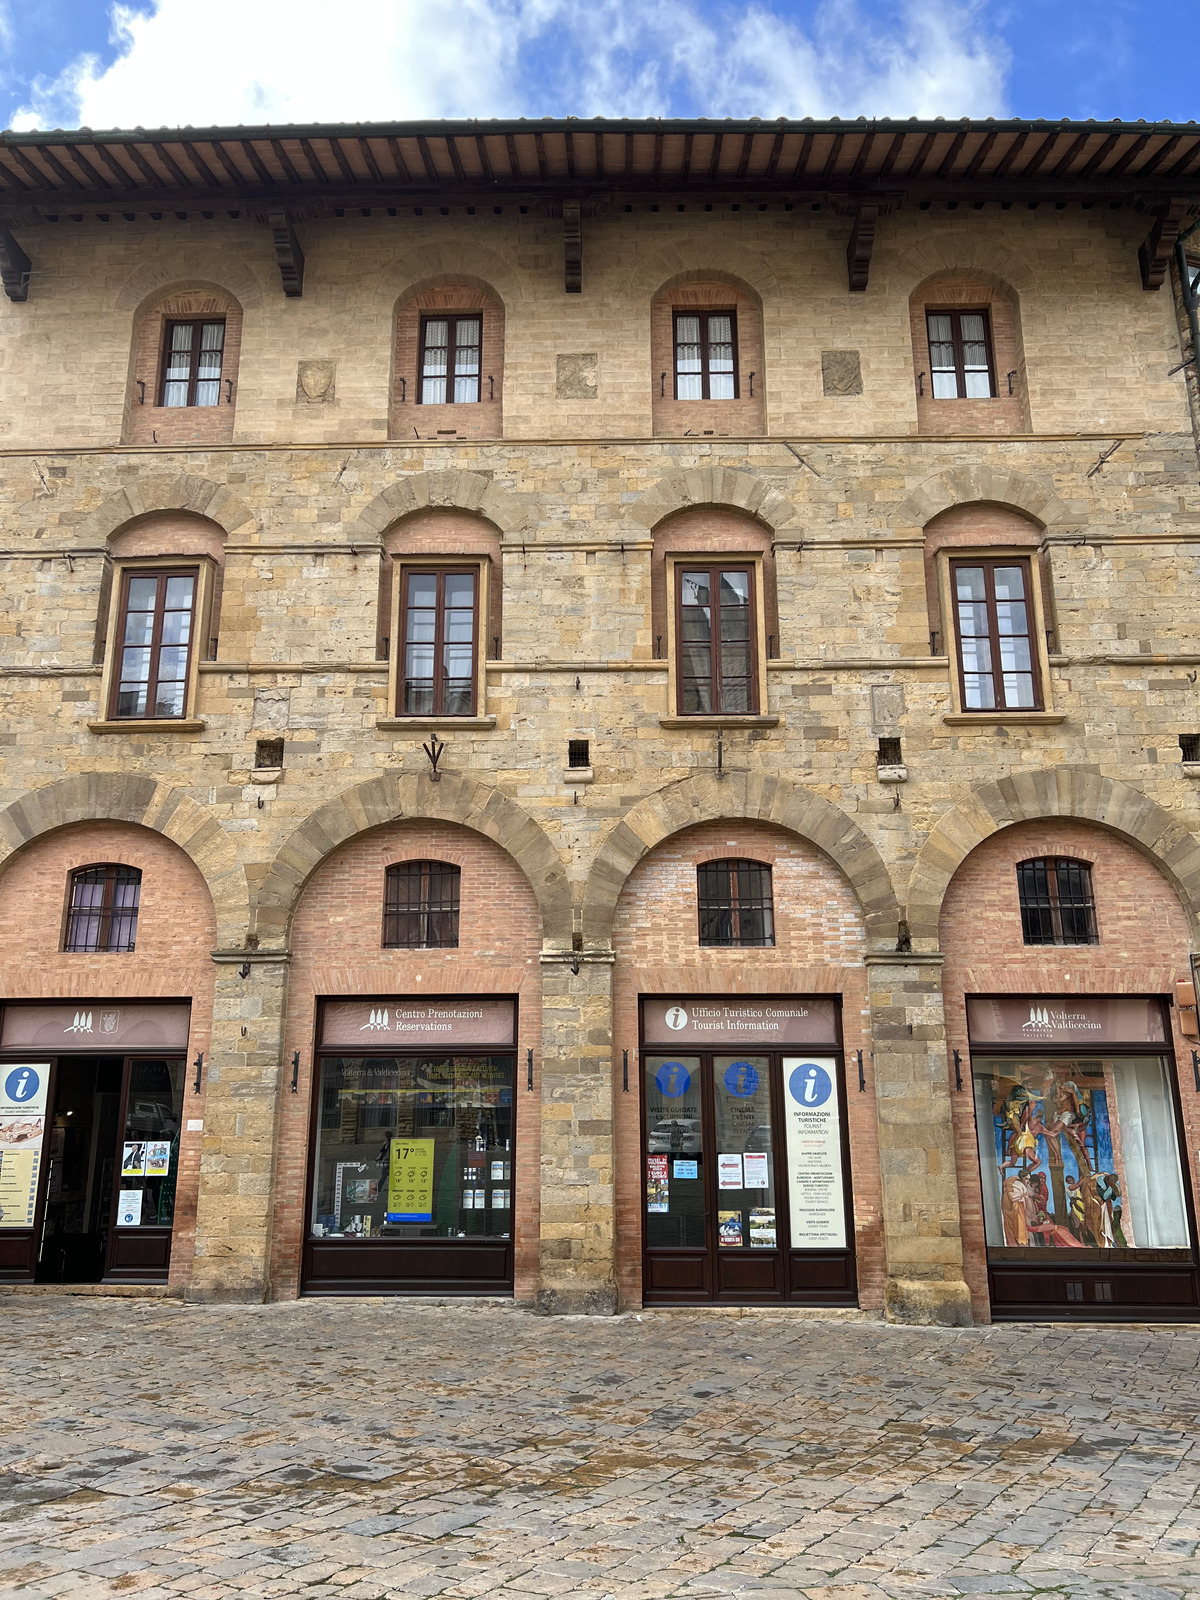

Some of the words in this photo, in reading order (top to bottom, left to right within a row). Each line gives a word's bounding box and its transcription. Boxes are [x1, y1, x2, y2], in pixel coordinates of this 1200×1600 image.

[395, 1009, 426, 1019] Centro
[428, 1008, 483, 1019] Prenotazioni
[692, 1007, 721, 1018] Ufficio
[722, 1007, 763, 1018] Turistico
[765, 1007, 809, 1018] Comunale
[1050, 1011, 1086, 1020] Volterra
[395, 1021, 453, 1031] Reservations
[692, 1020, 724, 1030] Tourist
[726, 1020, 779, 1030] Information
[1051, 1020, 1102, 1029] Valdicecina
[396, 1148, 415, 1160] 17°
